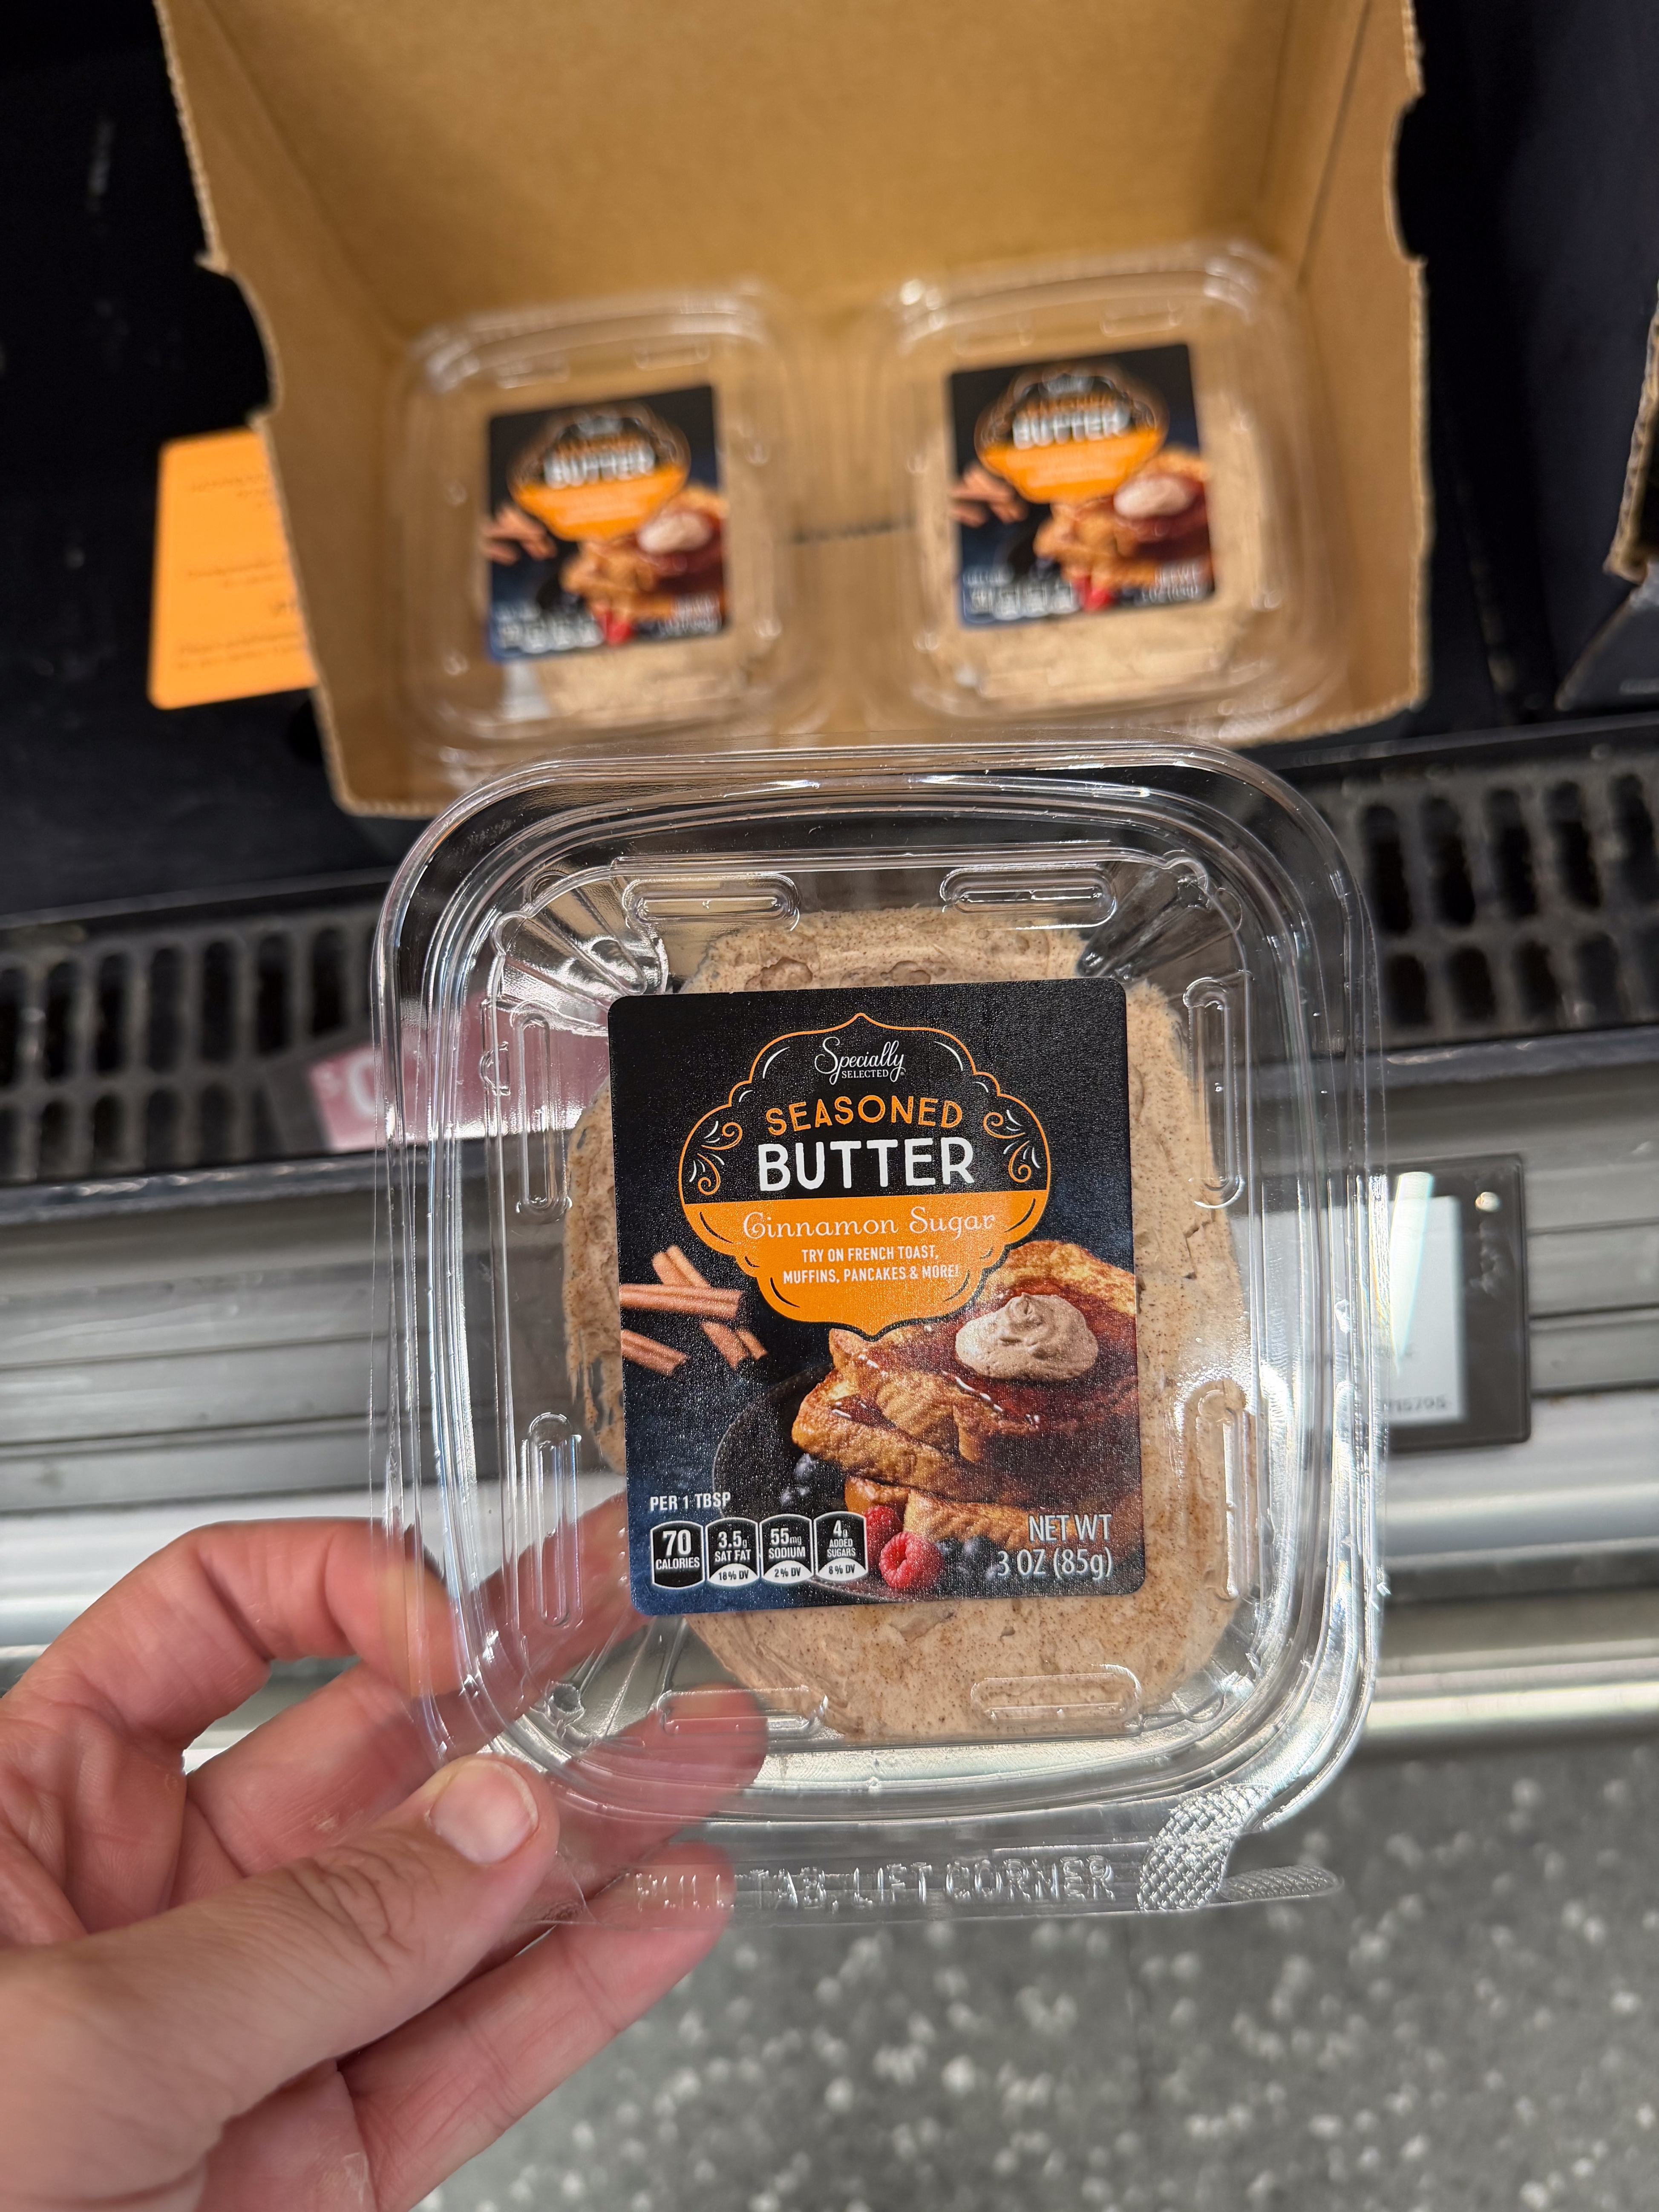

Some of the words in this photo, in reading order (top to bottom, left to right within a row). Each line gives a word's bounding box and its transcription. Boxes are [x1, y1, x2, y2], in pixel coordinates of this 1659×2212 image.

[815, 1037, 906, 1085] Specially
[841, 1069, 889, 1079] SELECTED
[766, 1094, 962, 1135] SEASONED
[758, 1137, 975, 1192] BUTTER
[743, 1211, 899, 1239] Cinnamon
[909, 1206, 995, 1241] Sugar
[801, 1248, 824, 1263] TRY
[828, 1248, 844, 1262] ON
[848, 1246, 894, 1261] FRENCH
[898, 1244, 939, 1260] TOAST,
[783, 1269, 840, 1284] MUFFINS,
[844, 1266, 906, 1282] PANCAKES
[910, 1265, 918, 1279] &
[922, 1264, 959, 1279] MORE!
[650, 1495, 678, 1511] PER
[683, 1495, 688, 1509] 1
[694, 1492, 731, 1509] TBSP
[770, 1527, 802, 1545] 55mg
[833, 1520, 848, 1538] 4g
[1029, 1514, 1069, 1542] NET
[1074, 1514, 1112, 1541] WT
[662, 1529, 691, 1556] 70
[718, 1530, 748, 1548] 3.5g
[829, 1538, 853, 1548] ADDED
[714, 1550, 732, 1562] SAT
[734, 1549, 752, 1561] FAT
[768, 1546, 806, 1559] SODIUM
[827, 1548, 856, 1558] SUGARS
[656, 1557, 700, 1570] CALORIES
[791, 1567, 801, 1576] DV
[845, 1564, 855, 1573] DV
[998, 1551, 1010, 1576] 3
[1017, 1549, 1046, 1576] OZ
[1053, 1547, 1113, 1580] (85g)
[739, 1570, 749, 1579] DV
[853, 1862, 933, 1908] LIFT
[946, 1854, 1116, 1904] CORNER
